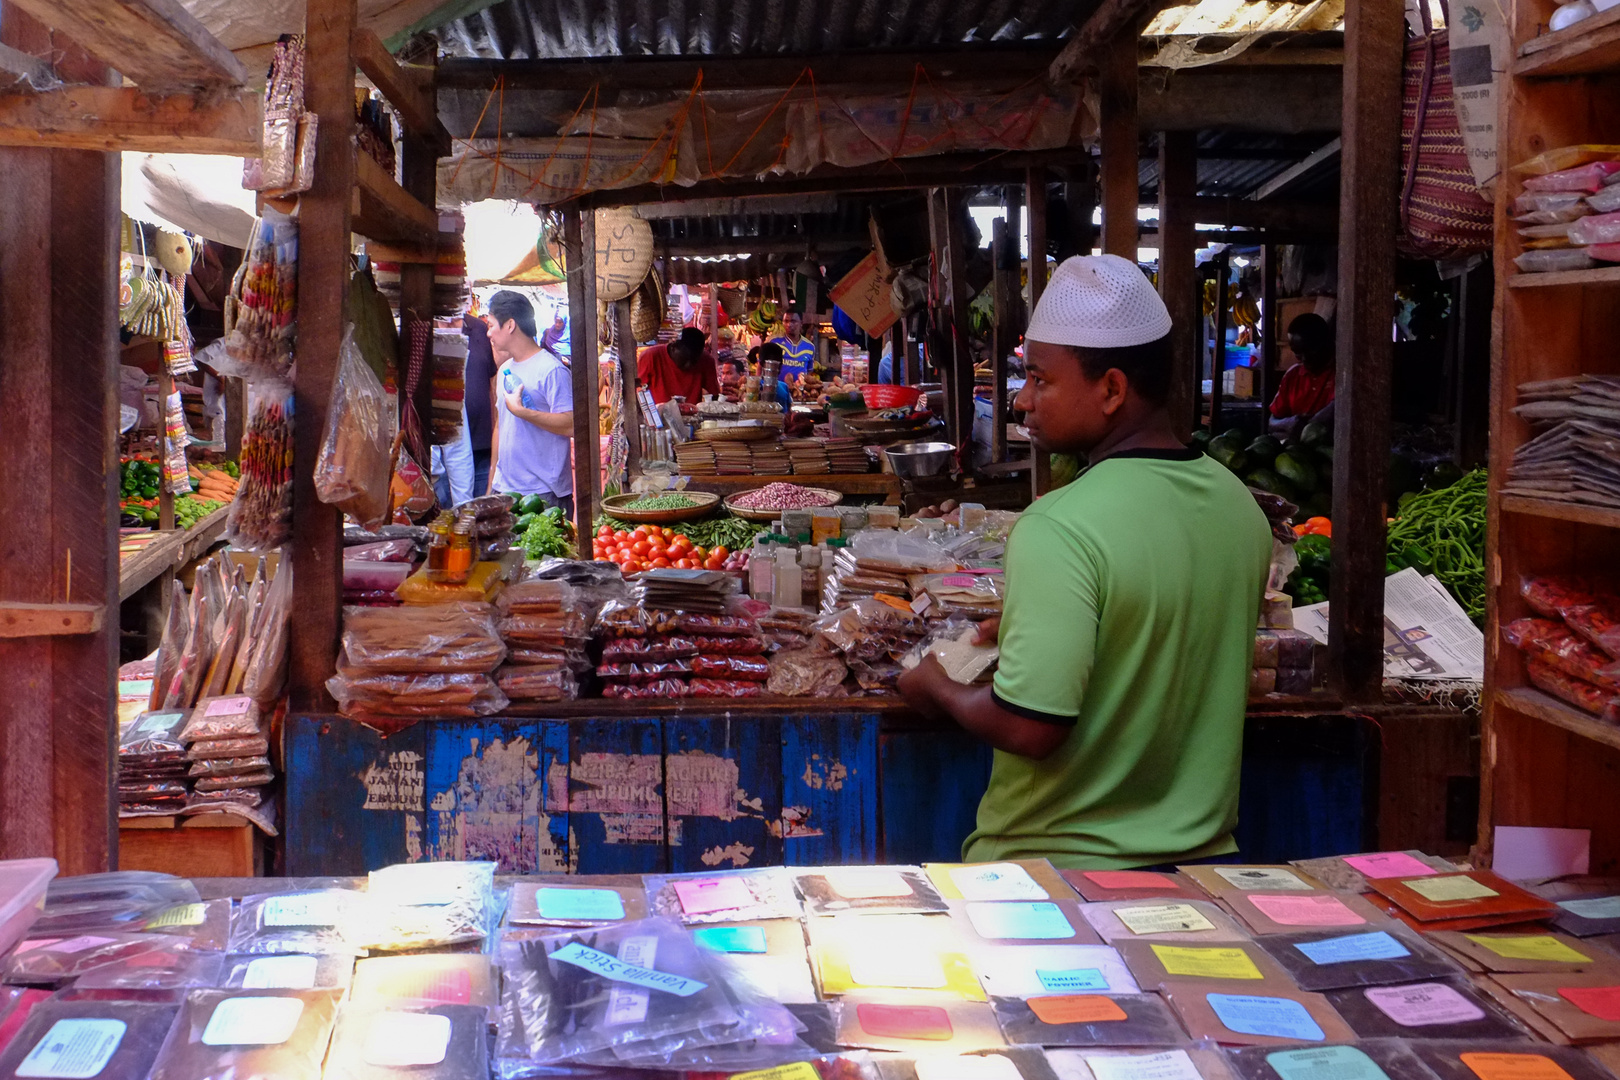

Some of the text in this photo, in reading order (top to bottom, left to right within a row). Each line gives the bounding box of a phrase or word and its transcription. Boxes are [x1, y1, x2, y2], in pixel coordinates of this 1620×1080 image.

[782, 358, 805, 368] ANZIBAR
[574, 948, 688, 990] Vanilla Stick
